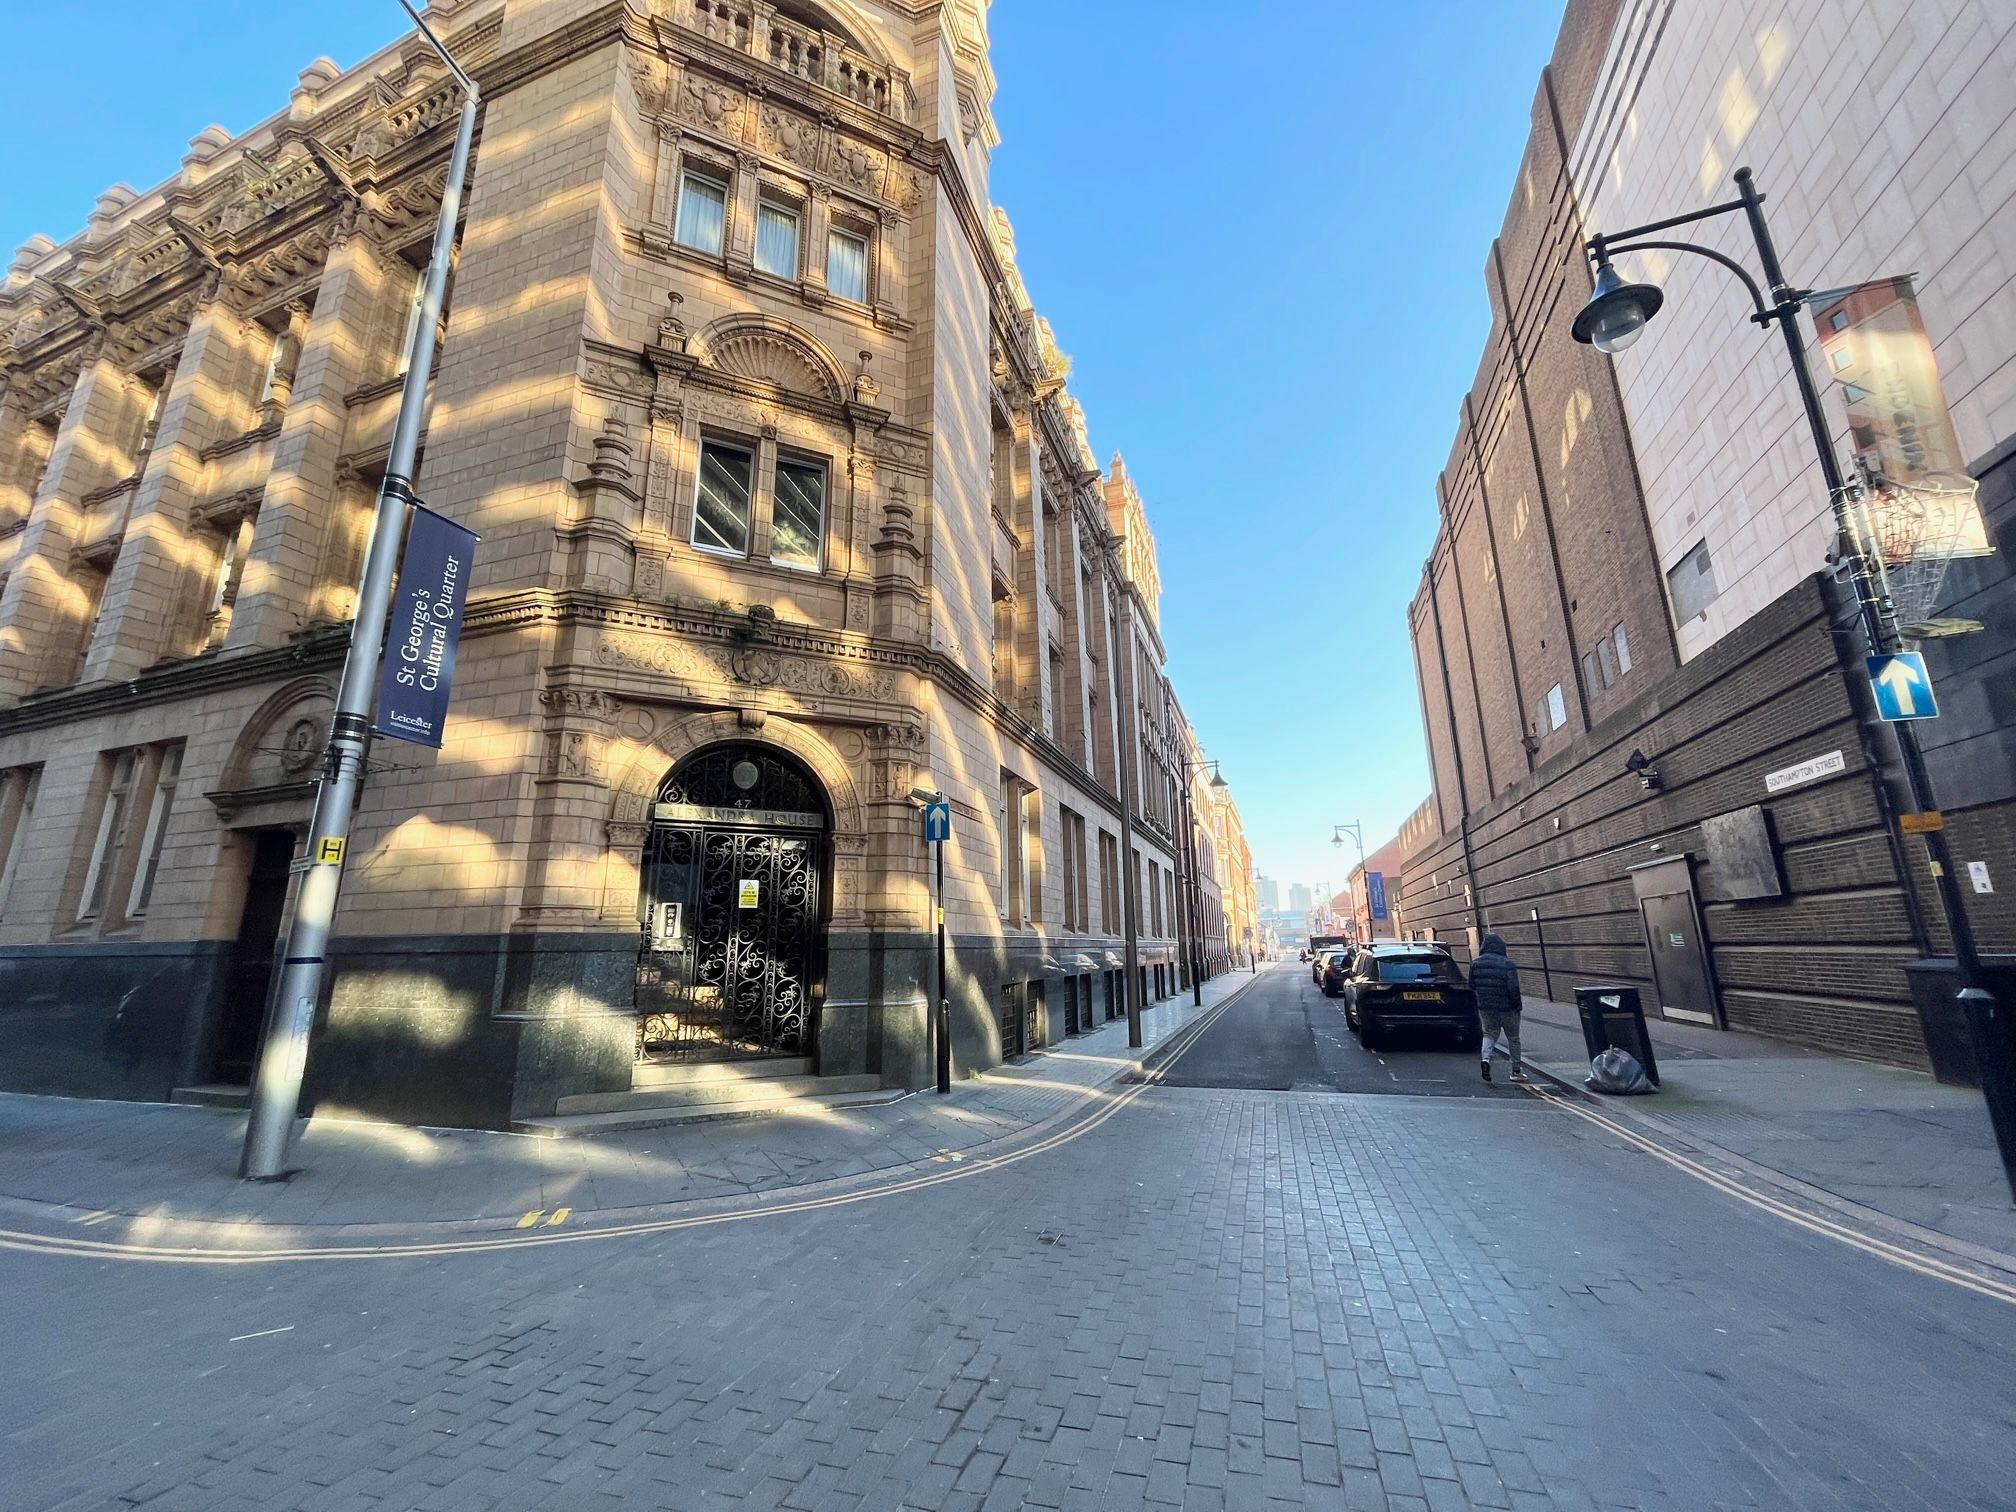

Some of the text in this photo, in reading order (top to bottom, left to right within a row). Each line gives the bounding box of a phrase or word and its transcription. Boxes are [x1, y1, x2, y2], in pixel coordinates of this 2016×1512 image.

[420, 555, 460, 692] Cultural Quarter
[397, 587, 431, 687] St George's
[390, 710, 433, 729] Leicester
[1767, 755, 1841, 788] SOUTHAMPTON STREET
[734, 799, 752, 809] 47
[665, 807, 814, 826] ALEXANDRA HOUSE
[321, 839, 342, 861] H
